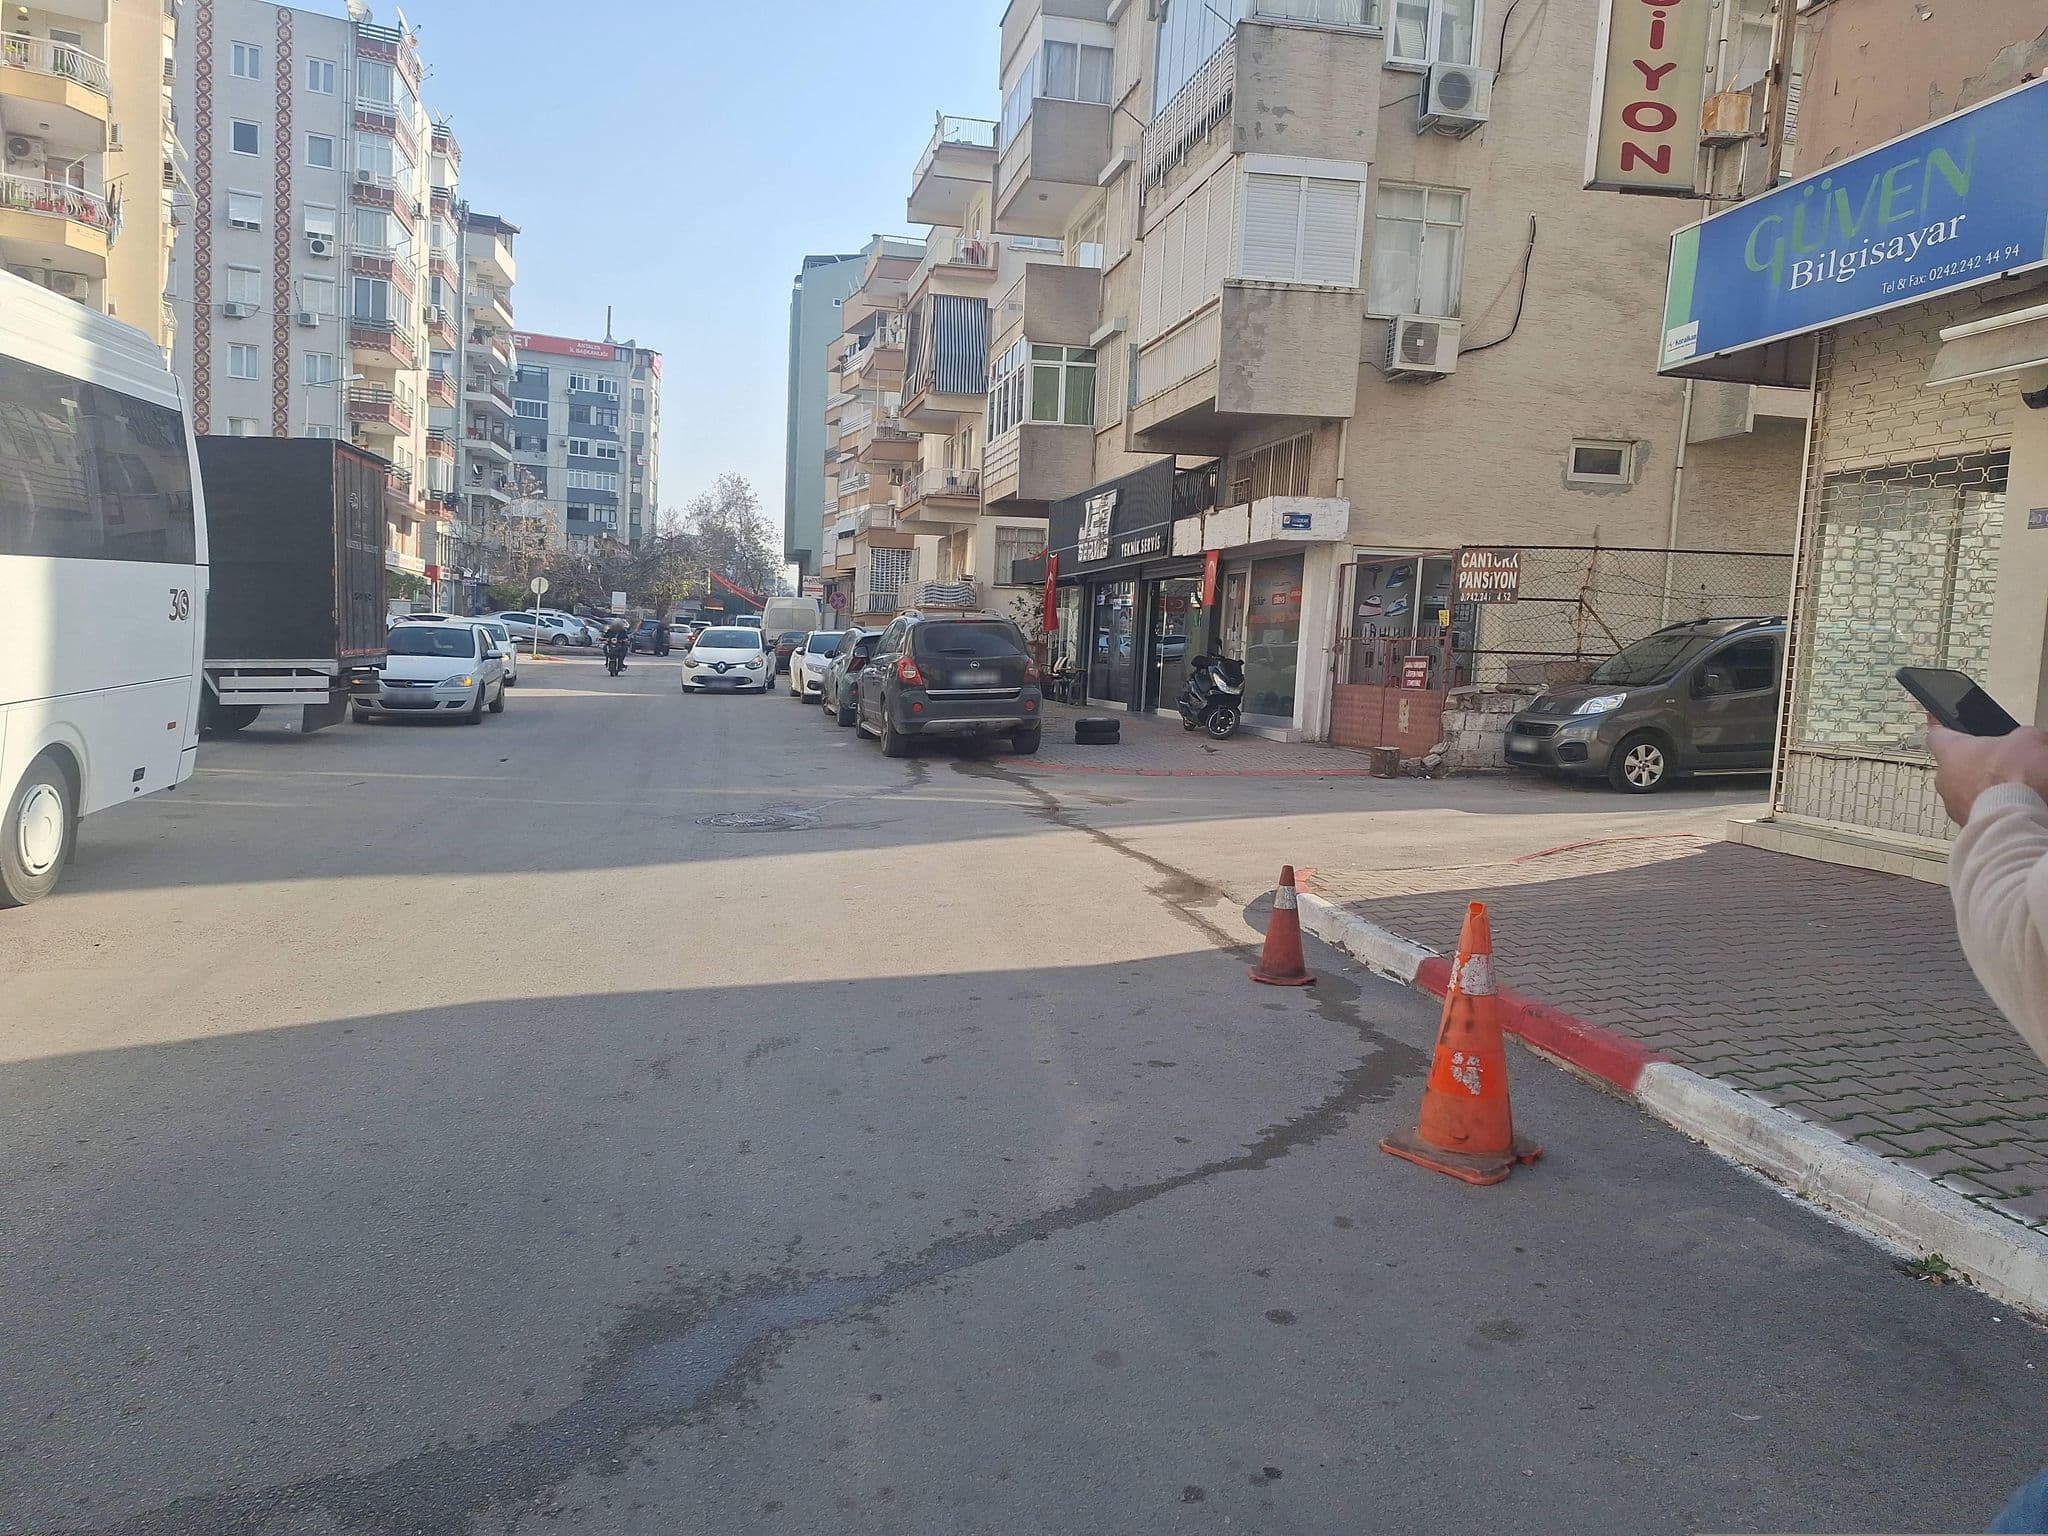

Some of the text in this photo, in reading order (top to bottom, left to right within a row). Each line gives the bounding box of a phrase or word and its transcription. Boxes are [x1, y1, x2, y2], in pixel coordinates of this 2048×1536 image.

[1620, 0, 1678, 174] İYON
[1743, 131, 1977, 288] GÜVEN
[1788, 213, 1968, 291] Bilgisayar
[1881, 280, 1895, 295] Tel
[1897, 277, 1908, 291] &
[1909, 273, 1927, 288] Fax:
[1985, 249, 2001, 265] 44
[2004, 243, 2021, 260] 94
[513, 334, 531, 347] ET
